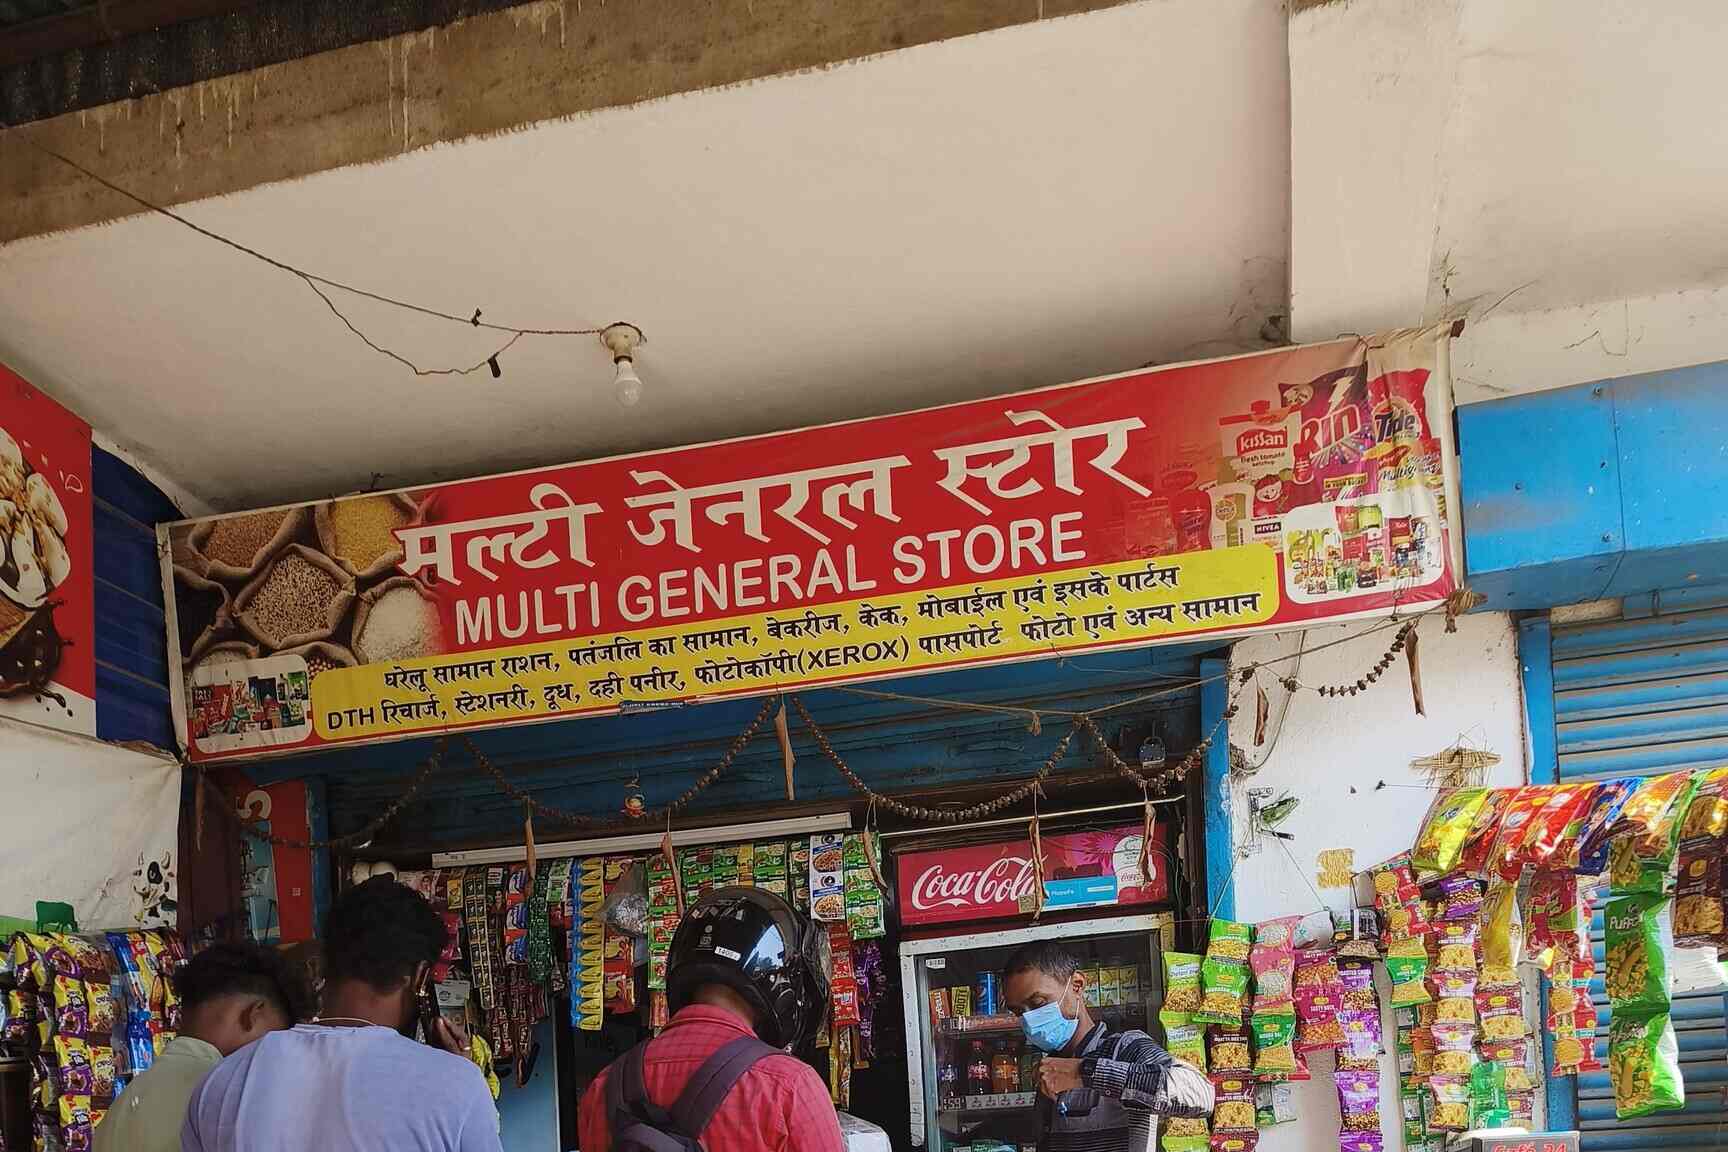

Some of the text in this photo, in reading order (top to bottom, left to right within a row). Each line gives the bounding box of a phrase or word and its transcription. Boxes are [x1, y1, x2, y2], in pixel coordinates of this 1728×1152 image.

[391, 410, 1152, 585] मल्टी जेनरल स्टोर
[384, 664, 428, 694] घरेलू
[432, 657, 495, 684] सामान
[500, 651, 561, 678] राशन,
[568, 637, 643, 667] पतंजलि
[648, 634, 676, 656] का
[682, 626, 758, 653] सामान,
[766, 611, 849, 641] बेकरीज,
[859, 601, 909, 630] केक,
[917, 589, 1005, 620] मोबाईल
[1013, 578, 1047, 613] एवं
[1053, 571, 1109, 603] इसके
[456, 511, 1087, 646] MULTI GENERAL STORE
[328, 711, 375, 730] DTH
[381, 697, 447, 726] रिचार्ज,
[455, 687, 536, 716] स्टेशनरी,
[543, 682, 581, 712] दूध,
[588, 675, 623, 700] दही
[629, 664, 686, 694] पनीर,
[918, 622, 1003, 656] पासपोर्ट
[1020, 608, 1076, 643] फोटो
[1083, 604, 1117, 640] एवं
[1125, 600, 1175, 628] अन्य
[1182, 591, 1261, 620] सामान
[912, 854, 1049, 910] Coca-Cola
